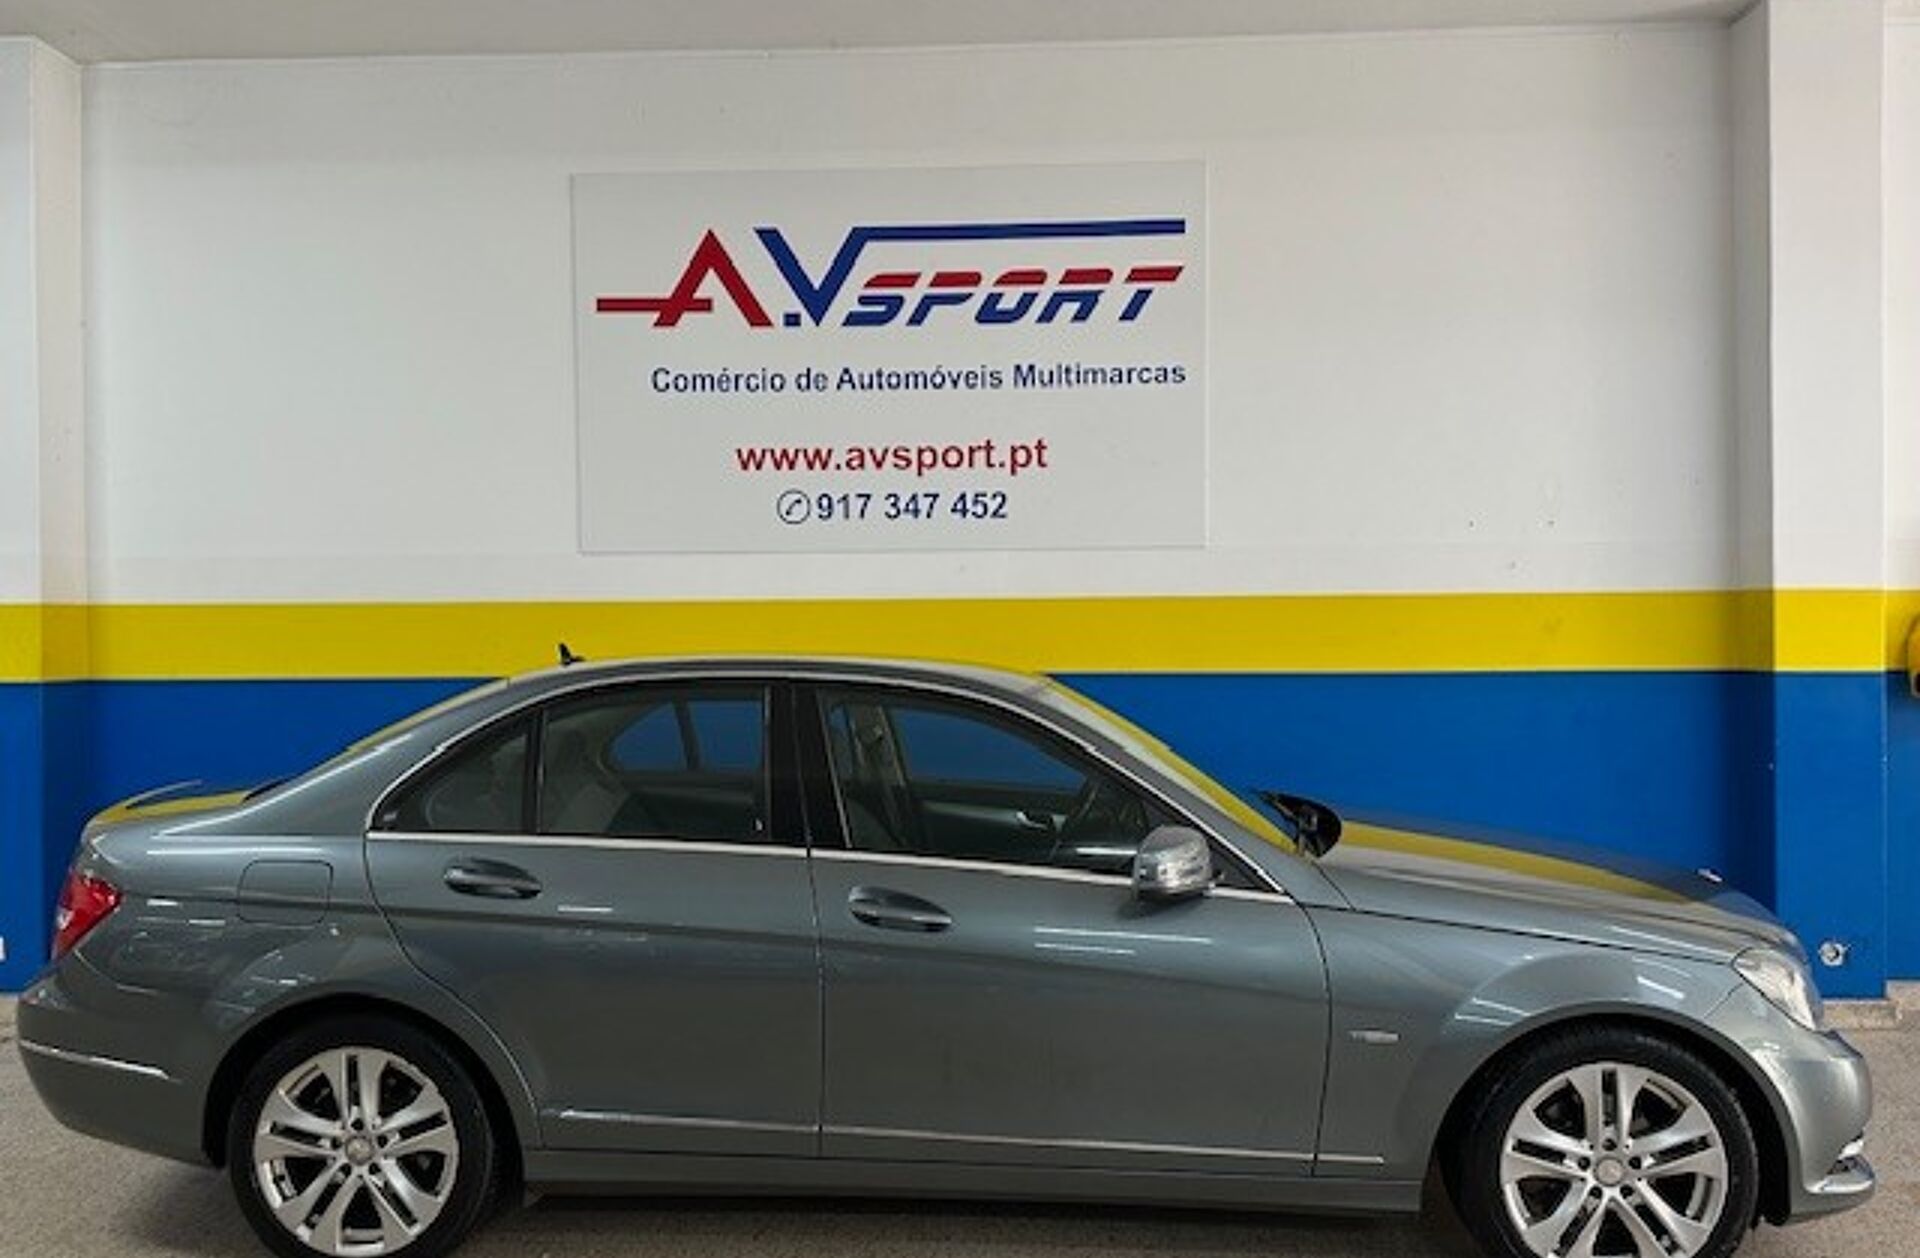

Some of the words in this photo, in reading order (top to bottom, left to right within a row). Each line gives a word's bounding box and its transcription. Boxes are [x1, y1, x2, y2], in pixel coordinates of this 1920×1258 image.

[652, 368, 786, 393] Comércio
[795, 367, 828, 392] de
[836, 365, 1003, 391] Automóveis
[1014, 363, 1186, 389] Multimarcas
[735, 439, 1048, 477] www.avsport.pt
[816, 493, 872, 521] 917
[885, 493, 940, 520] 347
[950, 491, 1007, 519] 452
